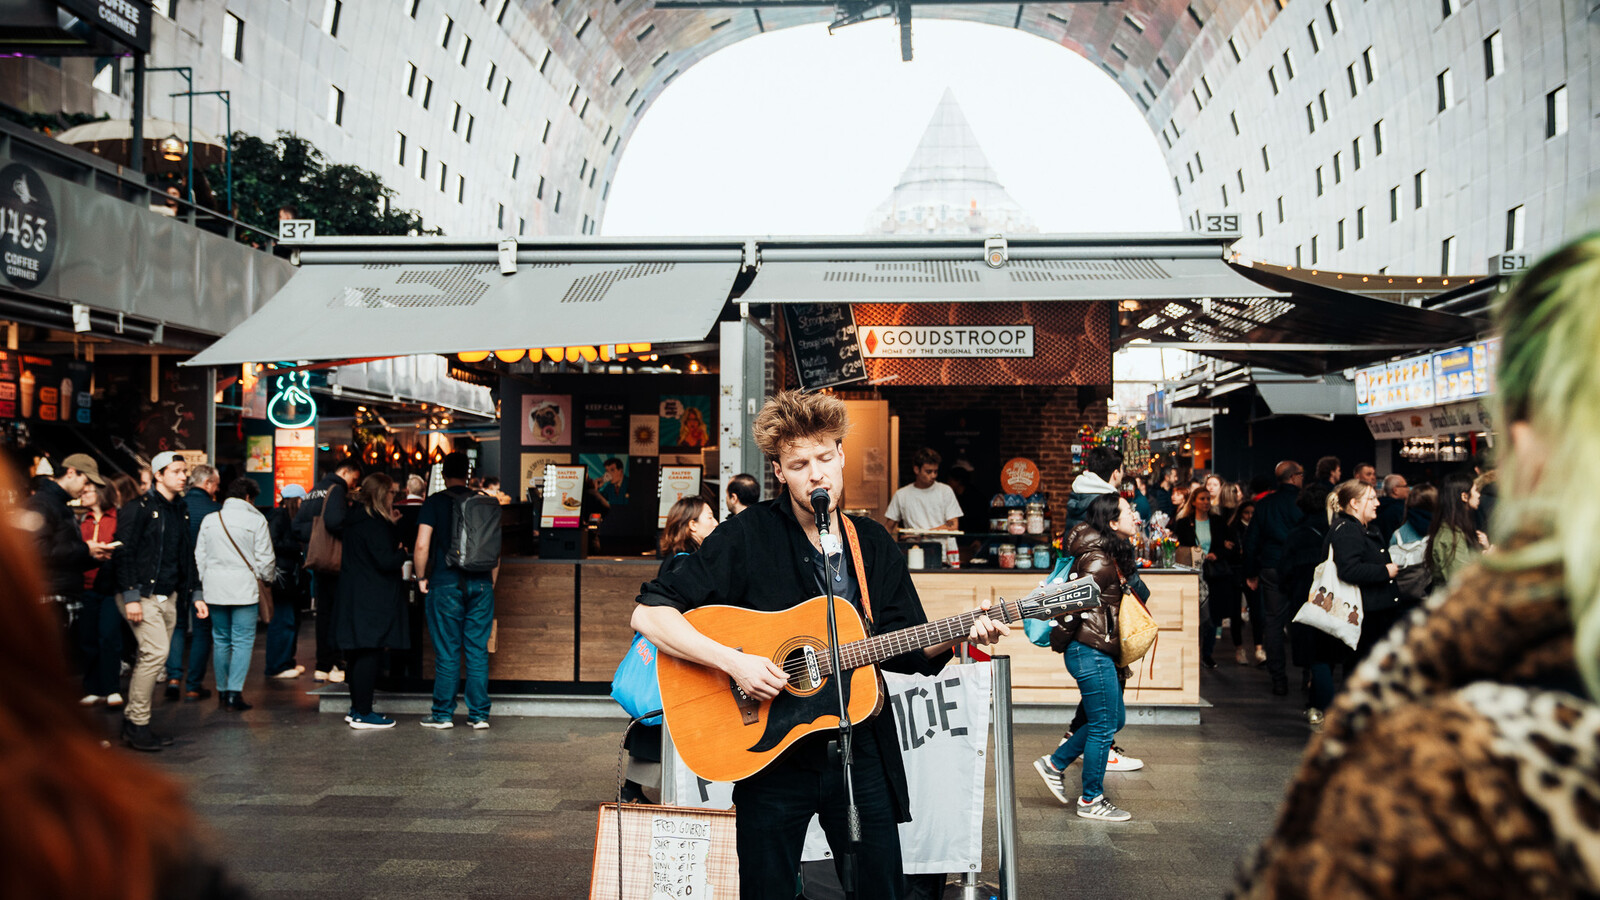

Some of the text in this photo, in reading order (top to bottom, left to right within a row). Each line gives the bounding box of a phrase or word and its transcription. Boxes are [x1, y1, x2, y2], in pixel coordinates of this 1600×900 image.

[98, 5, 137, 38] CORNER
[283, 223, 311, 239] 37
[1208, 216, 1238, 232] 39
[5, 252, 40, 271] COFFEE
[1503, 256, 1529, 270] 61
[6, 265, 38, 281] CORNER
[882, 330, 1026, 345] GOUDSTROOP
[636, 638, 654, 665] HAY
[655, 851, 666, 860] CD
